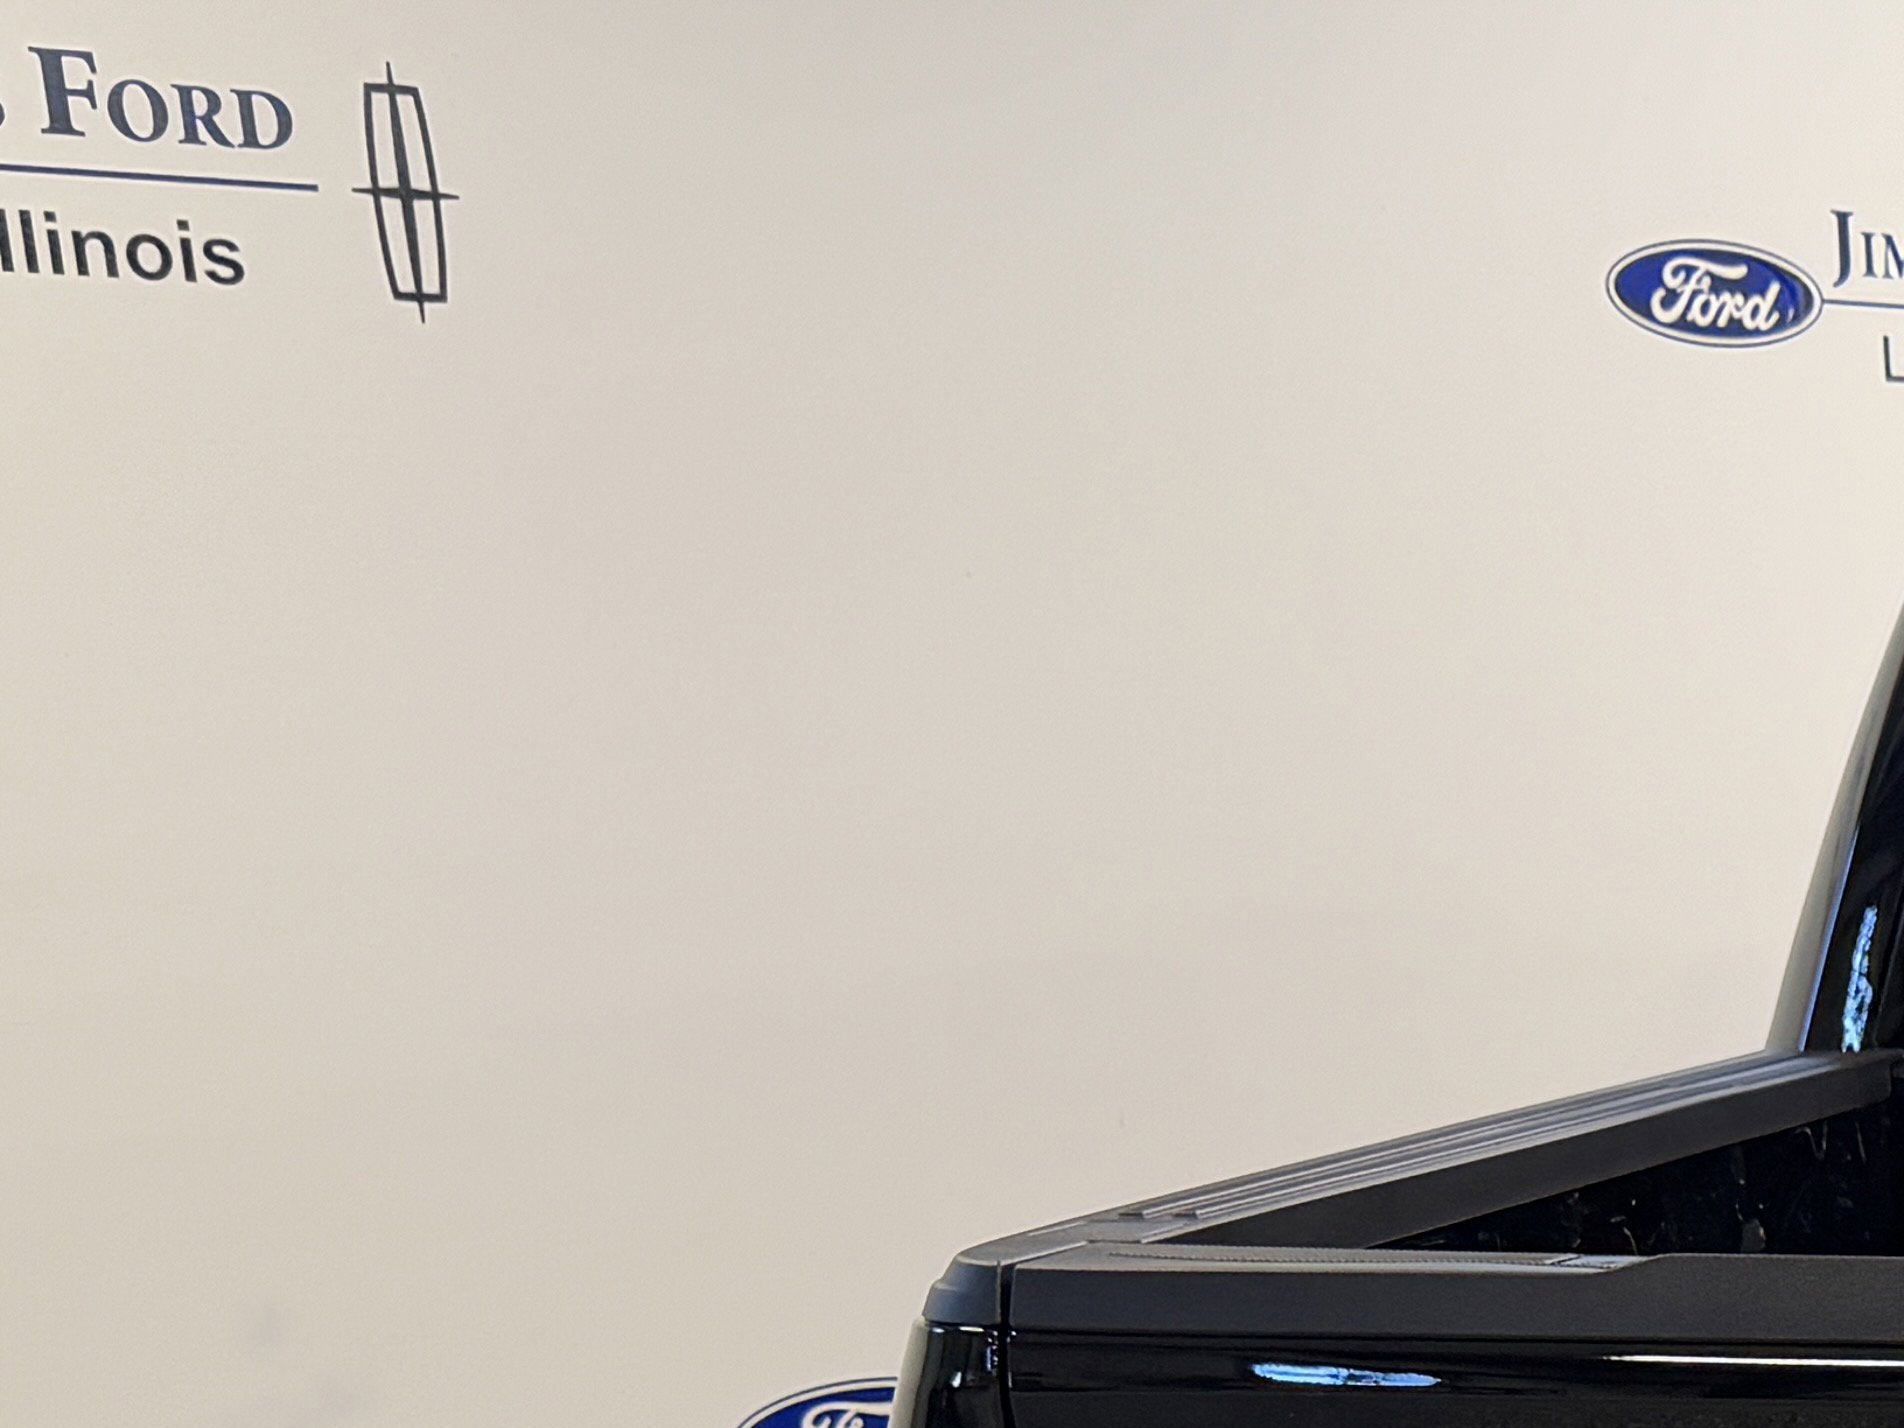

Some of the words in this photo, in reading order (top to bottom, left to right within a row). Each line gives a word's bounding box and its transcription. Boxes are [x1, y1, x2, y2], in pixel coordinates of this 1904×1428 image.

[28, 46, 294, 150] FORD
[0, 208, 245, 286] llinois
[1649, 256, 1782, 332] Ford
